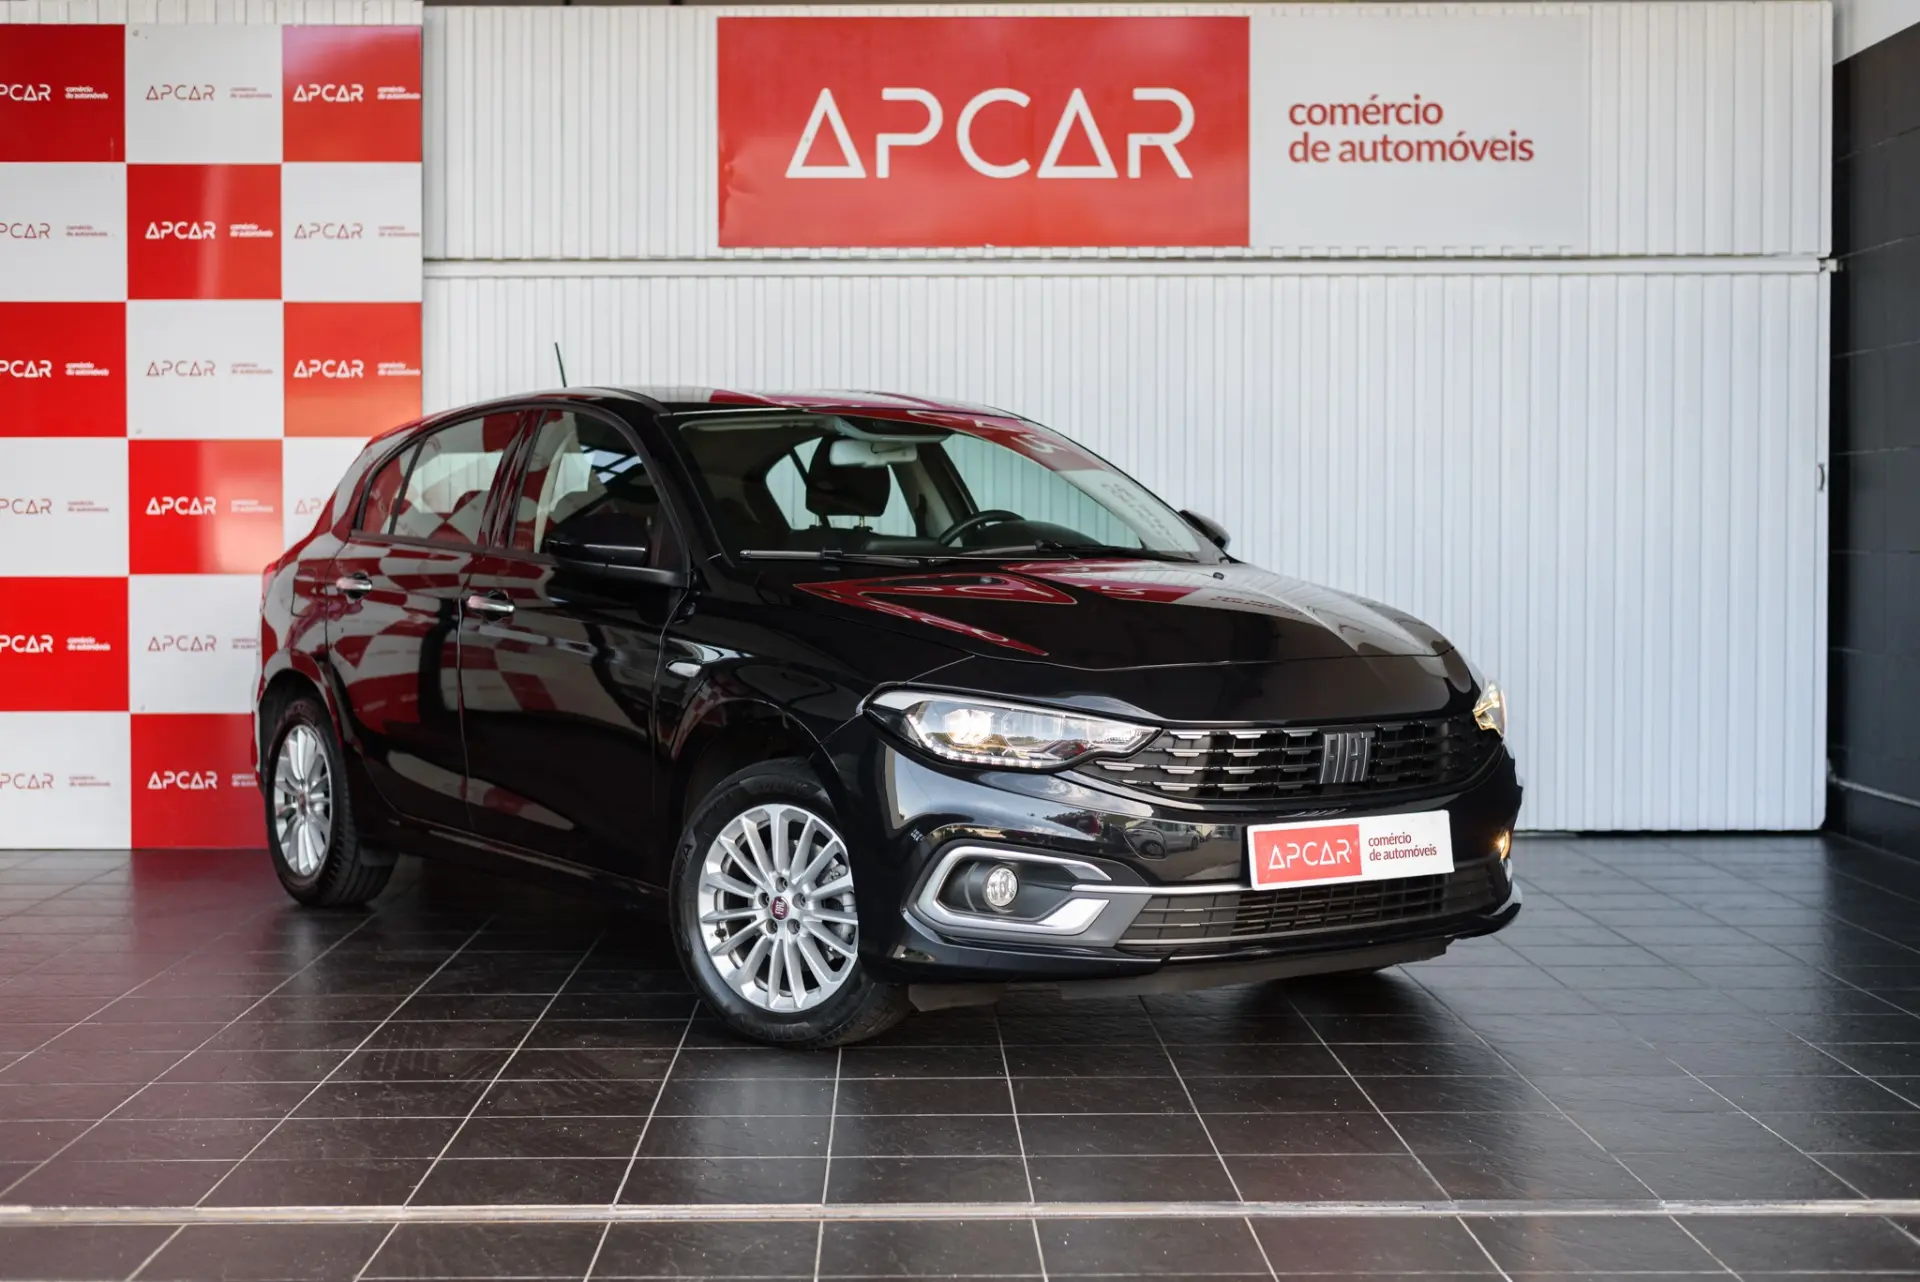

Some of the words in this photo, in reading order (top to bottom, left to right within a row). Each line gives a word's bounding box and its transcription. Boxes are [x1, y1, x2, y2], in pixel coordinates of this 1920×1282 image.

[146, 84, 215, 101] APCAR
[293, 83, 363, 102] APCAR
[1289, 94, 1443, 126] comércio
[785, 88, 1194, 179] APCAR
[1289, 132, 1330, 163] de
[1338, 130, 1535, 163] automóveis
[145, 222, 216, 240] APCAR
[294, 222, 363, 239] APCAR
[146, 360, 215, 377] APCAR
[293, 360, 364, 378] APCAR
[146, 496, 216, 515] APCAR
[148, 635, 216, 652] APCAR
[1320, 731, 1375, 784] FIAT
[148, 771, 217, 789] APCAR
[1368, 832, 1412, 847] comércio
[1268, 839, 1350, 870] APCAR
[1369, 848, 1382, 861] de
[1383, 844, 1437, 861] automóveis
